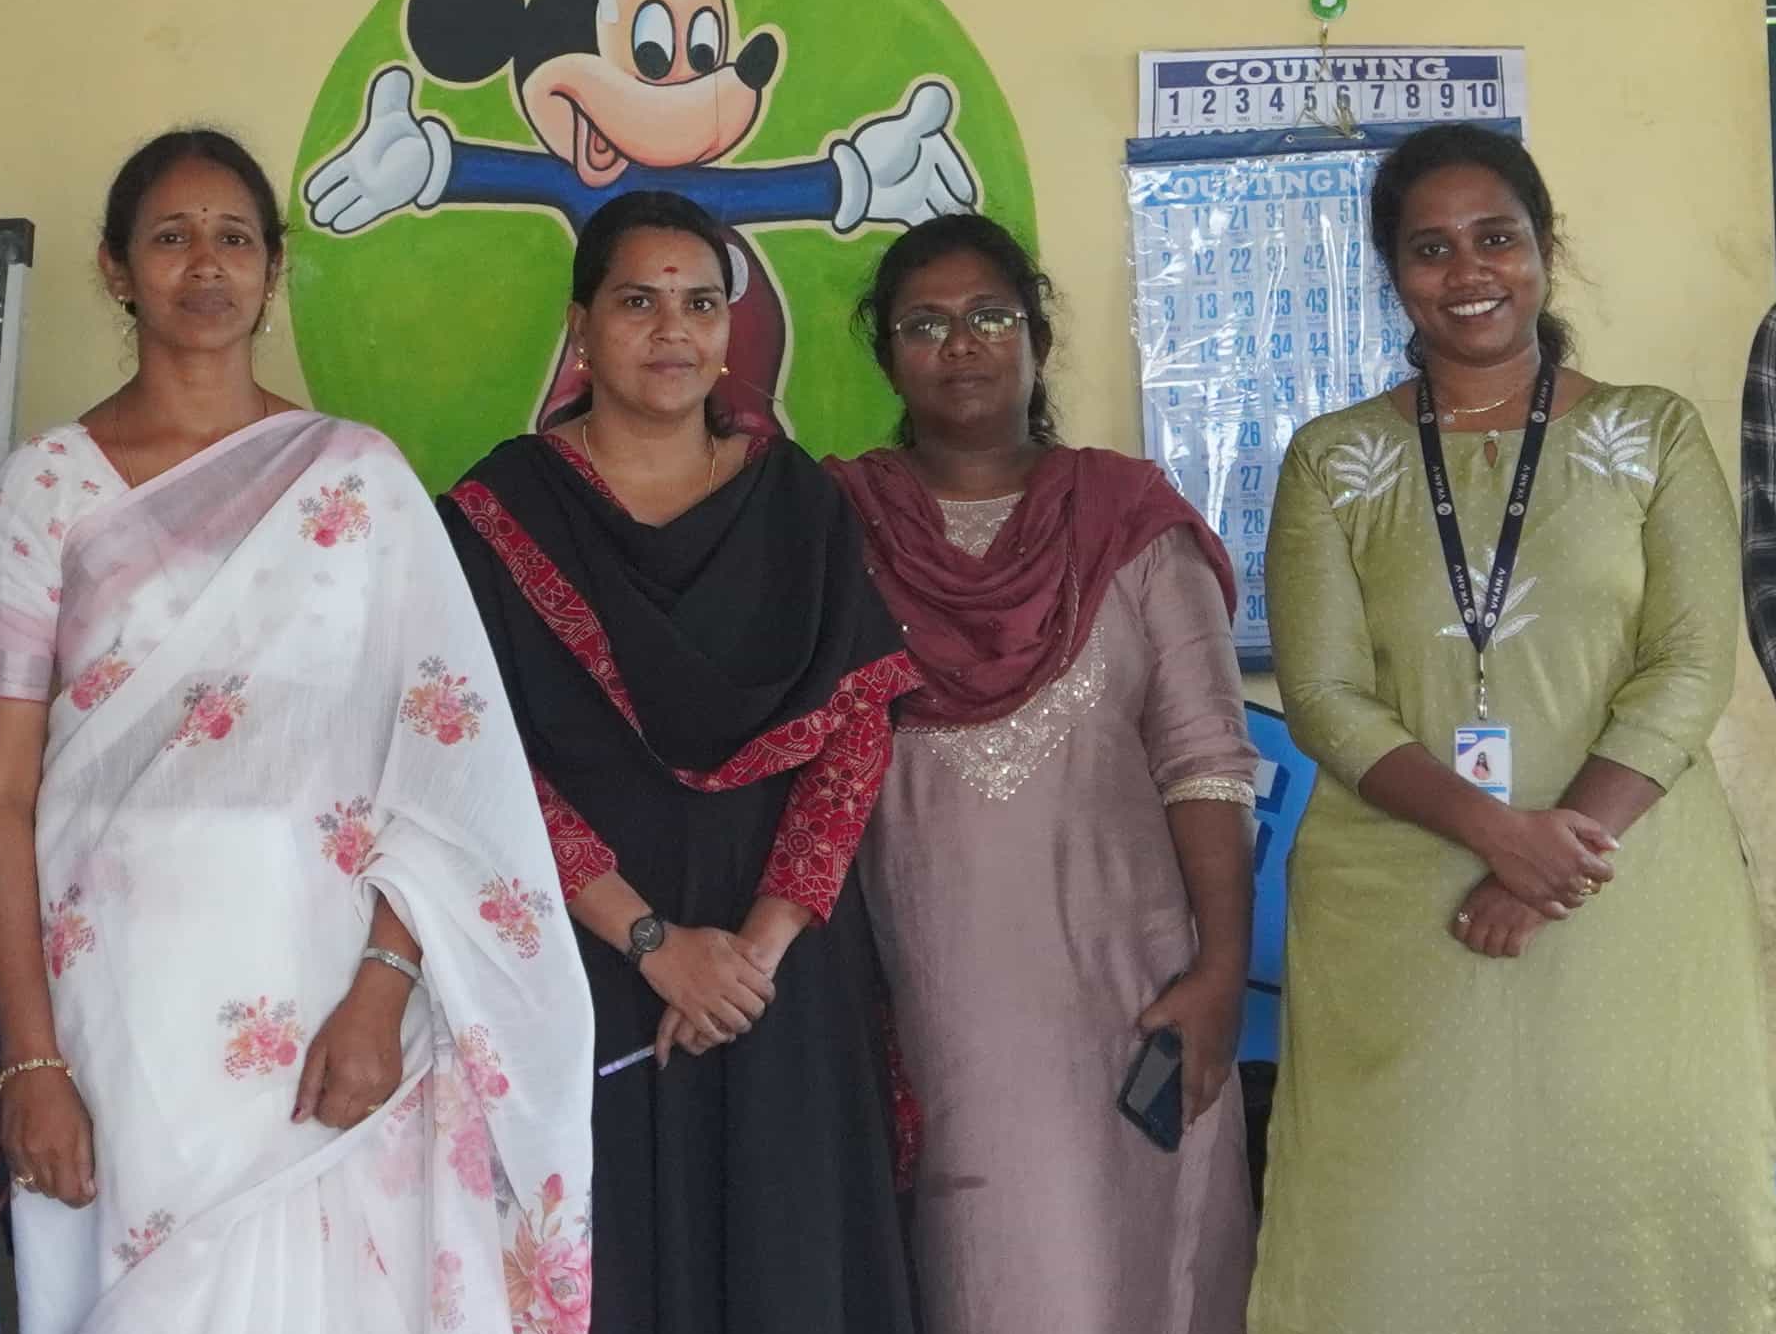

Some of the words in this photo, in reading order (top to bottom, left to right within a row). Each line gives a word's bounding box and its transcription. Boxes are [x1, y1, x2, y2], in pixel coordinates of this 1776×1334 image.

[1206, 57, 1450, 85] COUNTING
[1169, 91, 1180, 116] 1
[1202, 89, 1217, 115] 2
[1235, 88, 1250, 114] 3
[1269, 87, 1285, 112] 4
[1304, 86, 1318, 112] 5
[1336, 85, 1351, 110] 6
[1371, 84, 1385, 109] 7
[1405, 83, 1420, 109] 8
[1440, 83, 1455, 108] 9
[1466, 82, 1497, 108] 10
[1197, 293, 1217, 319] 13
[1305, 287, 1328, 314] 43
[1240, 421, 1260, 447] 26
[1241, 466, 1262, 492] 27
[1243, 509, 1264, 534] 28
